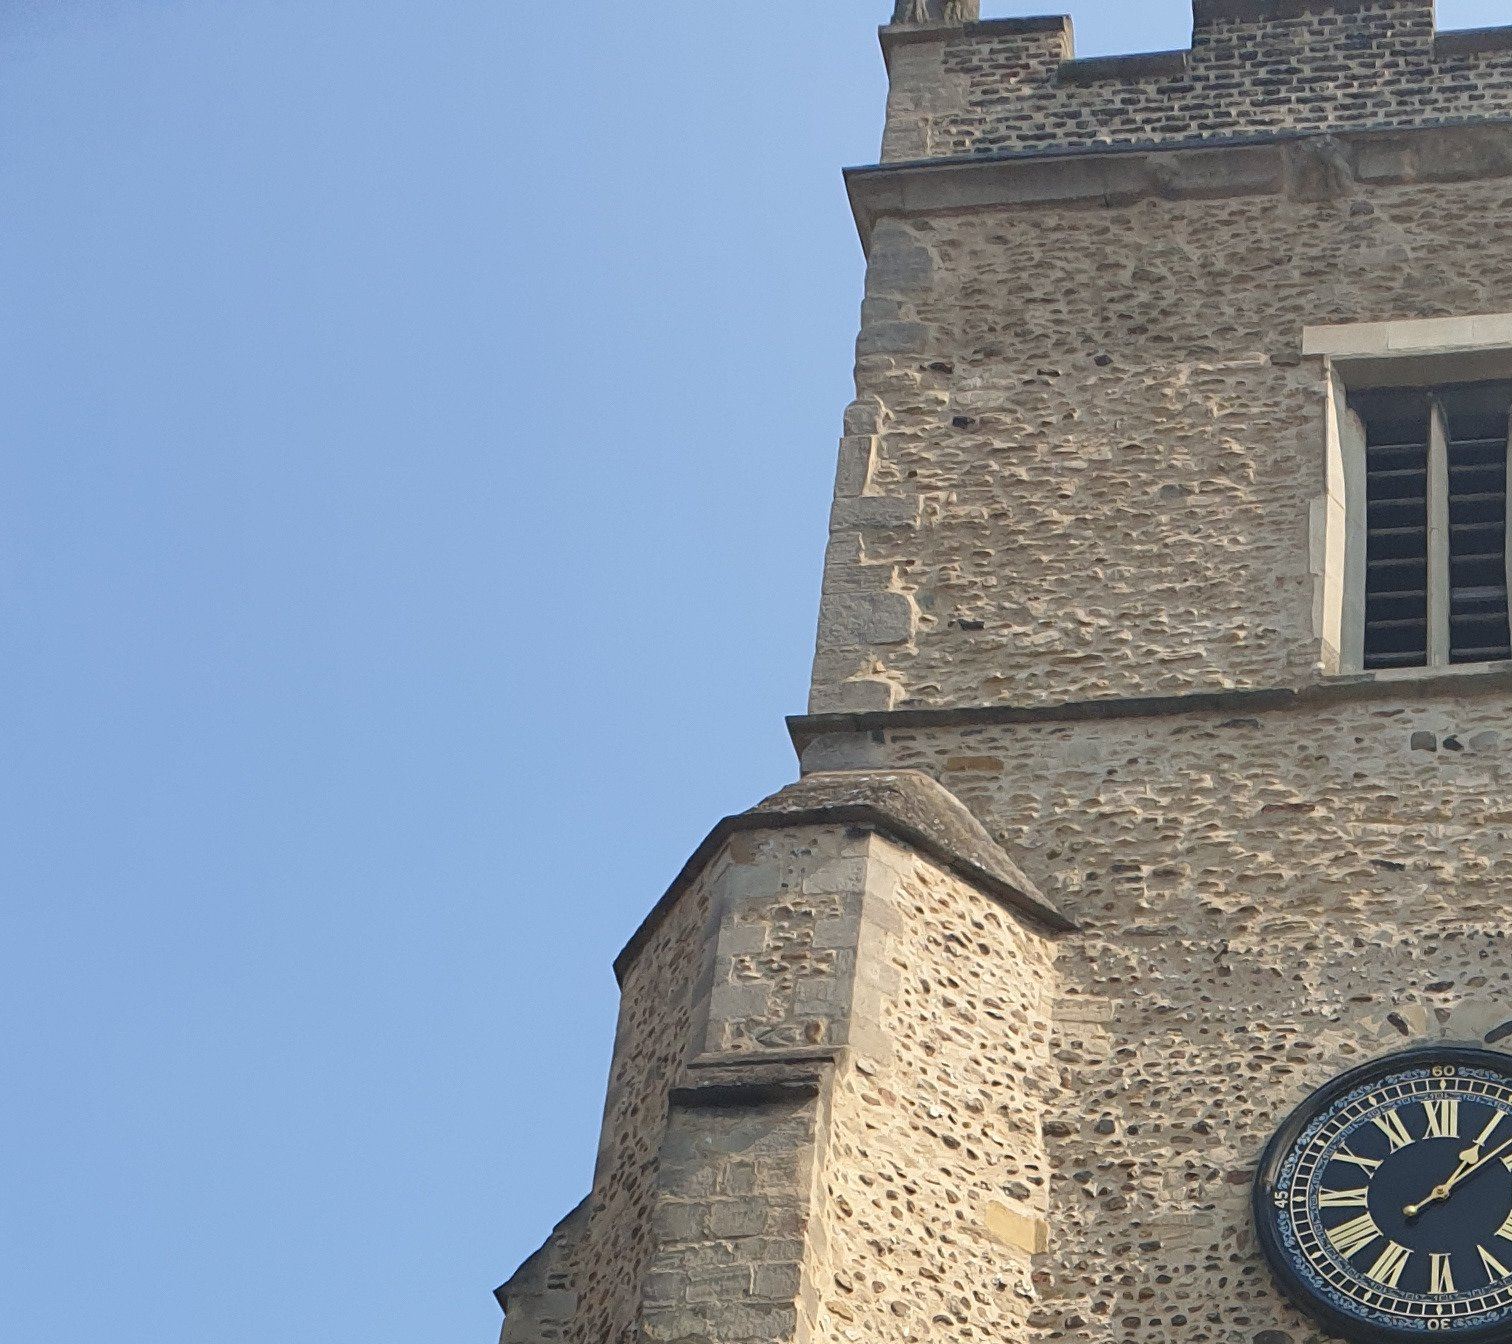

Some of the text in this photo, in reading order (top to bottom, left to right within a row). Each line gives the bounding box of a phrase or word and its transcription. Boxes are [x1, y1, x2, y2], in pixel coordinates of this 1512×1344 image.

[1431, 1065, 1455, 1077] 60
[1372, 1109, 1415, 1153] XI
[1421, 1099, 1460, 1140] XII
[1330, 1142, 1384, 1178] X
[1273, 1189, 1288, 1209] 45
[1325, 1212, 1384, 1258] VIII
[1365, 1241, 1414, 1289] VII
[1429, 1252, 1457, 1295] VI
